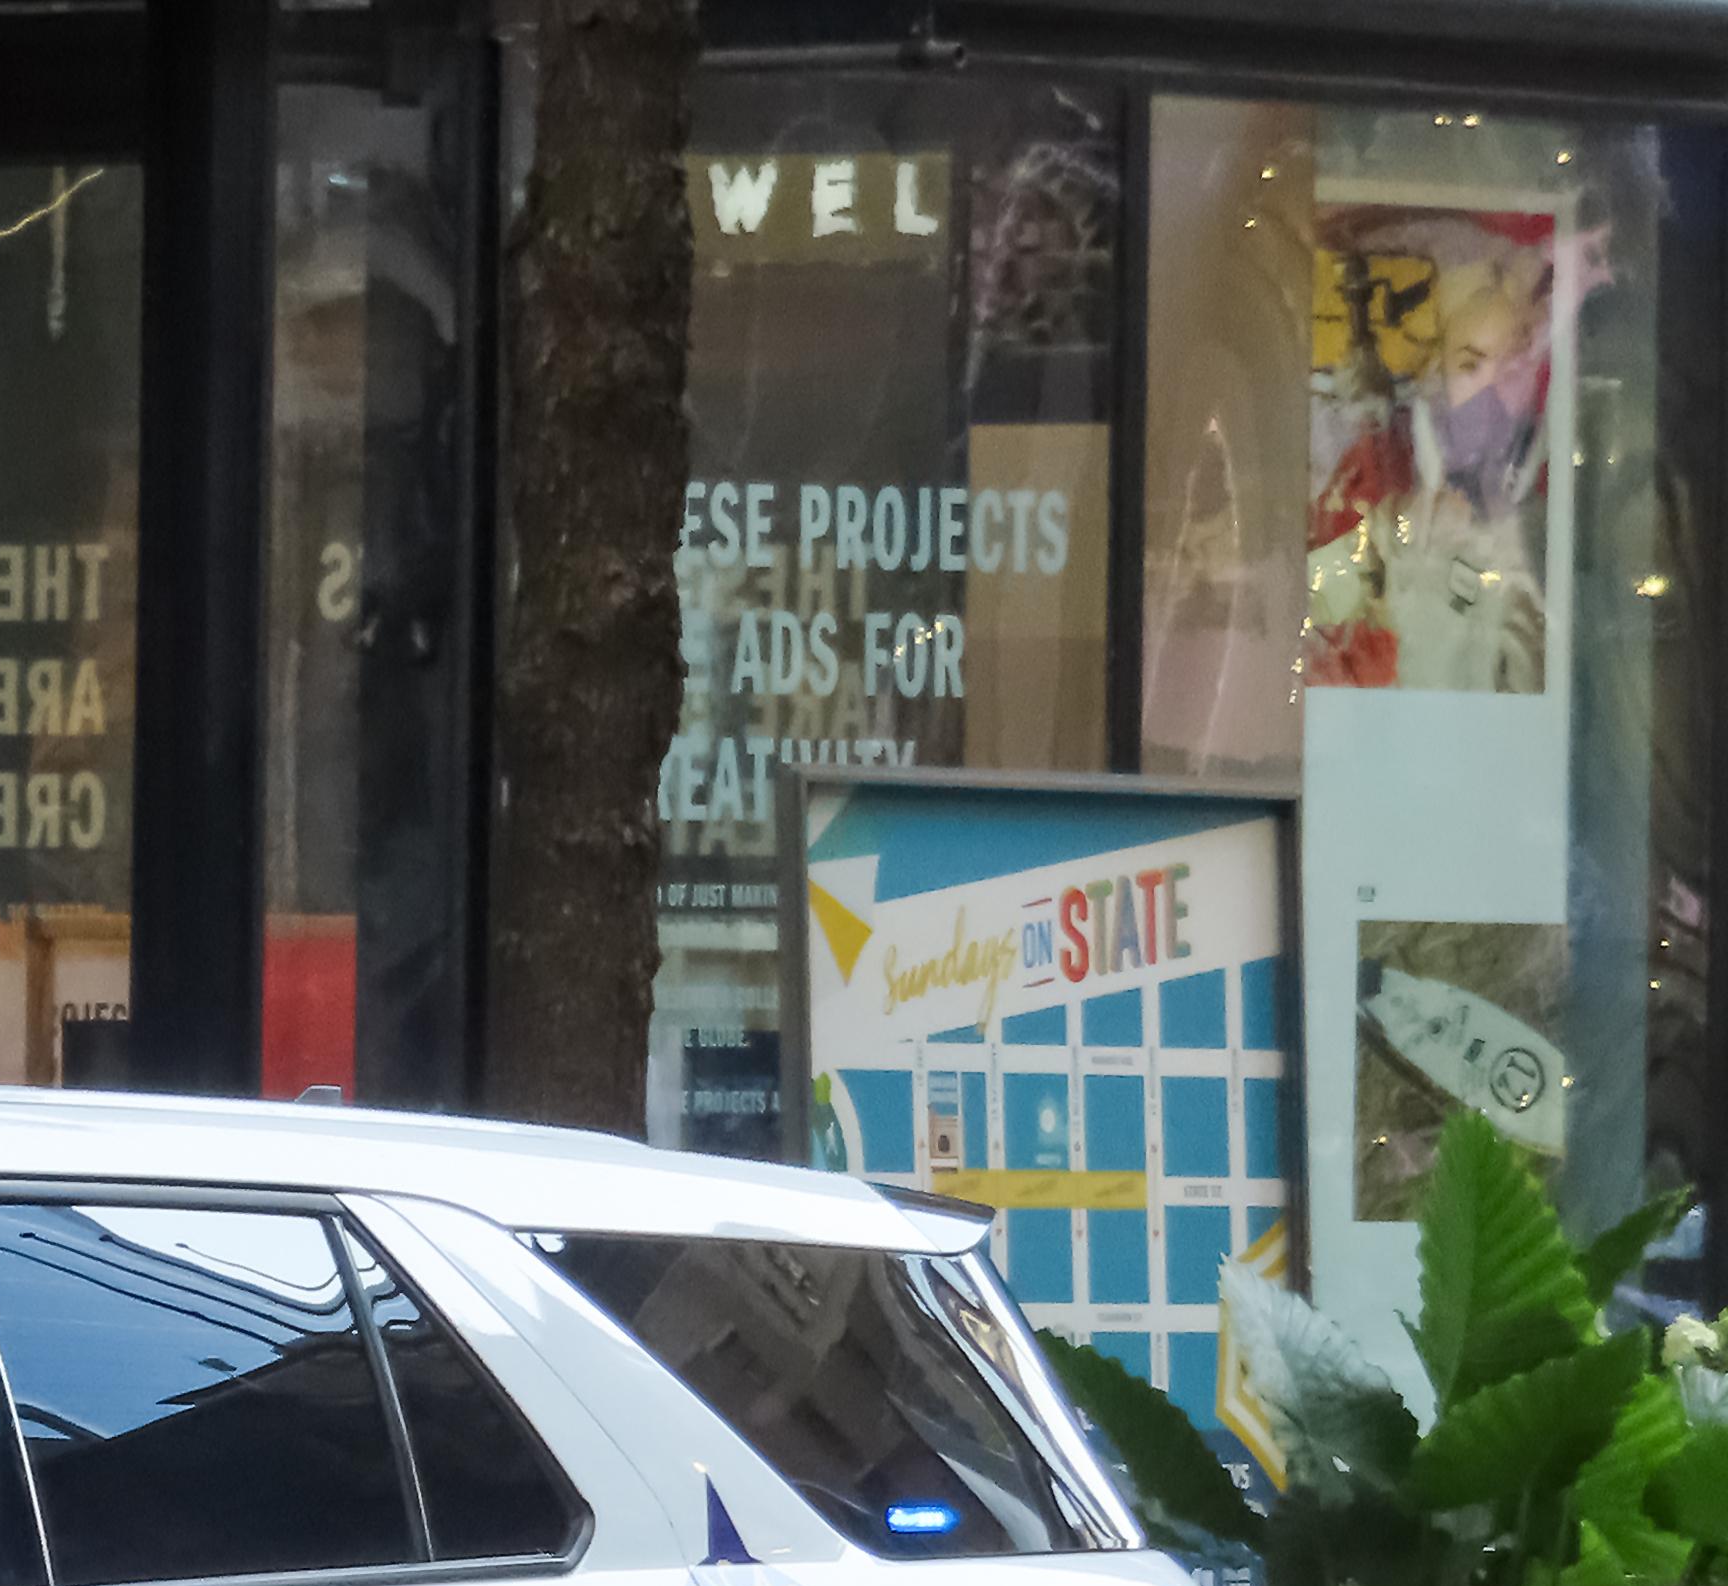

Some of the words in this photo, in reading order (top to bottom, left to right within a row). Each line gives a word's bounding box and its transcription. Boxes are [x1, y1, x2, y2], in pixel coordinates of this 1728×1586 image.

[800, 483, 1069, 575] PROJECTS
[731, 608, 840, 697] ADS
[864, 611, 966, 699] FOR
[883, 905, 1016, 1036] Sundays
[1022, 919, 1053, 969] ON
[1059, 862, 1191, 983] STATE
